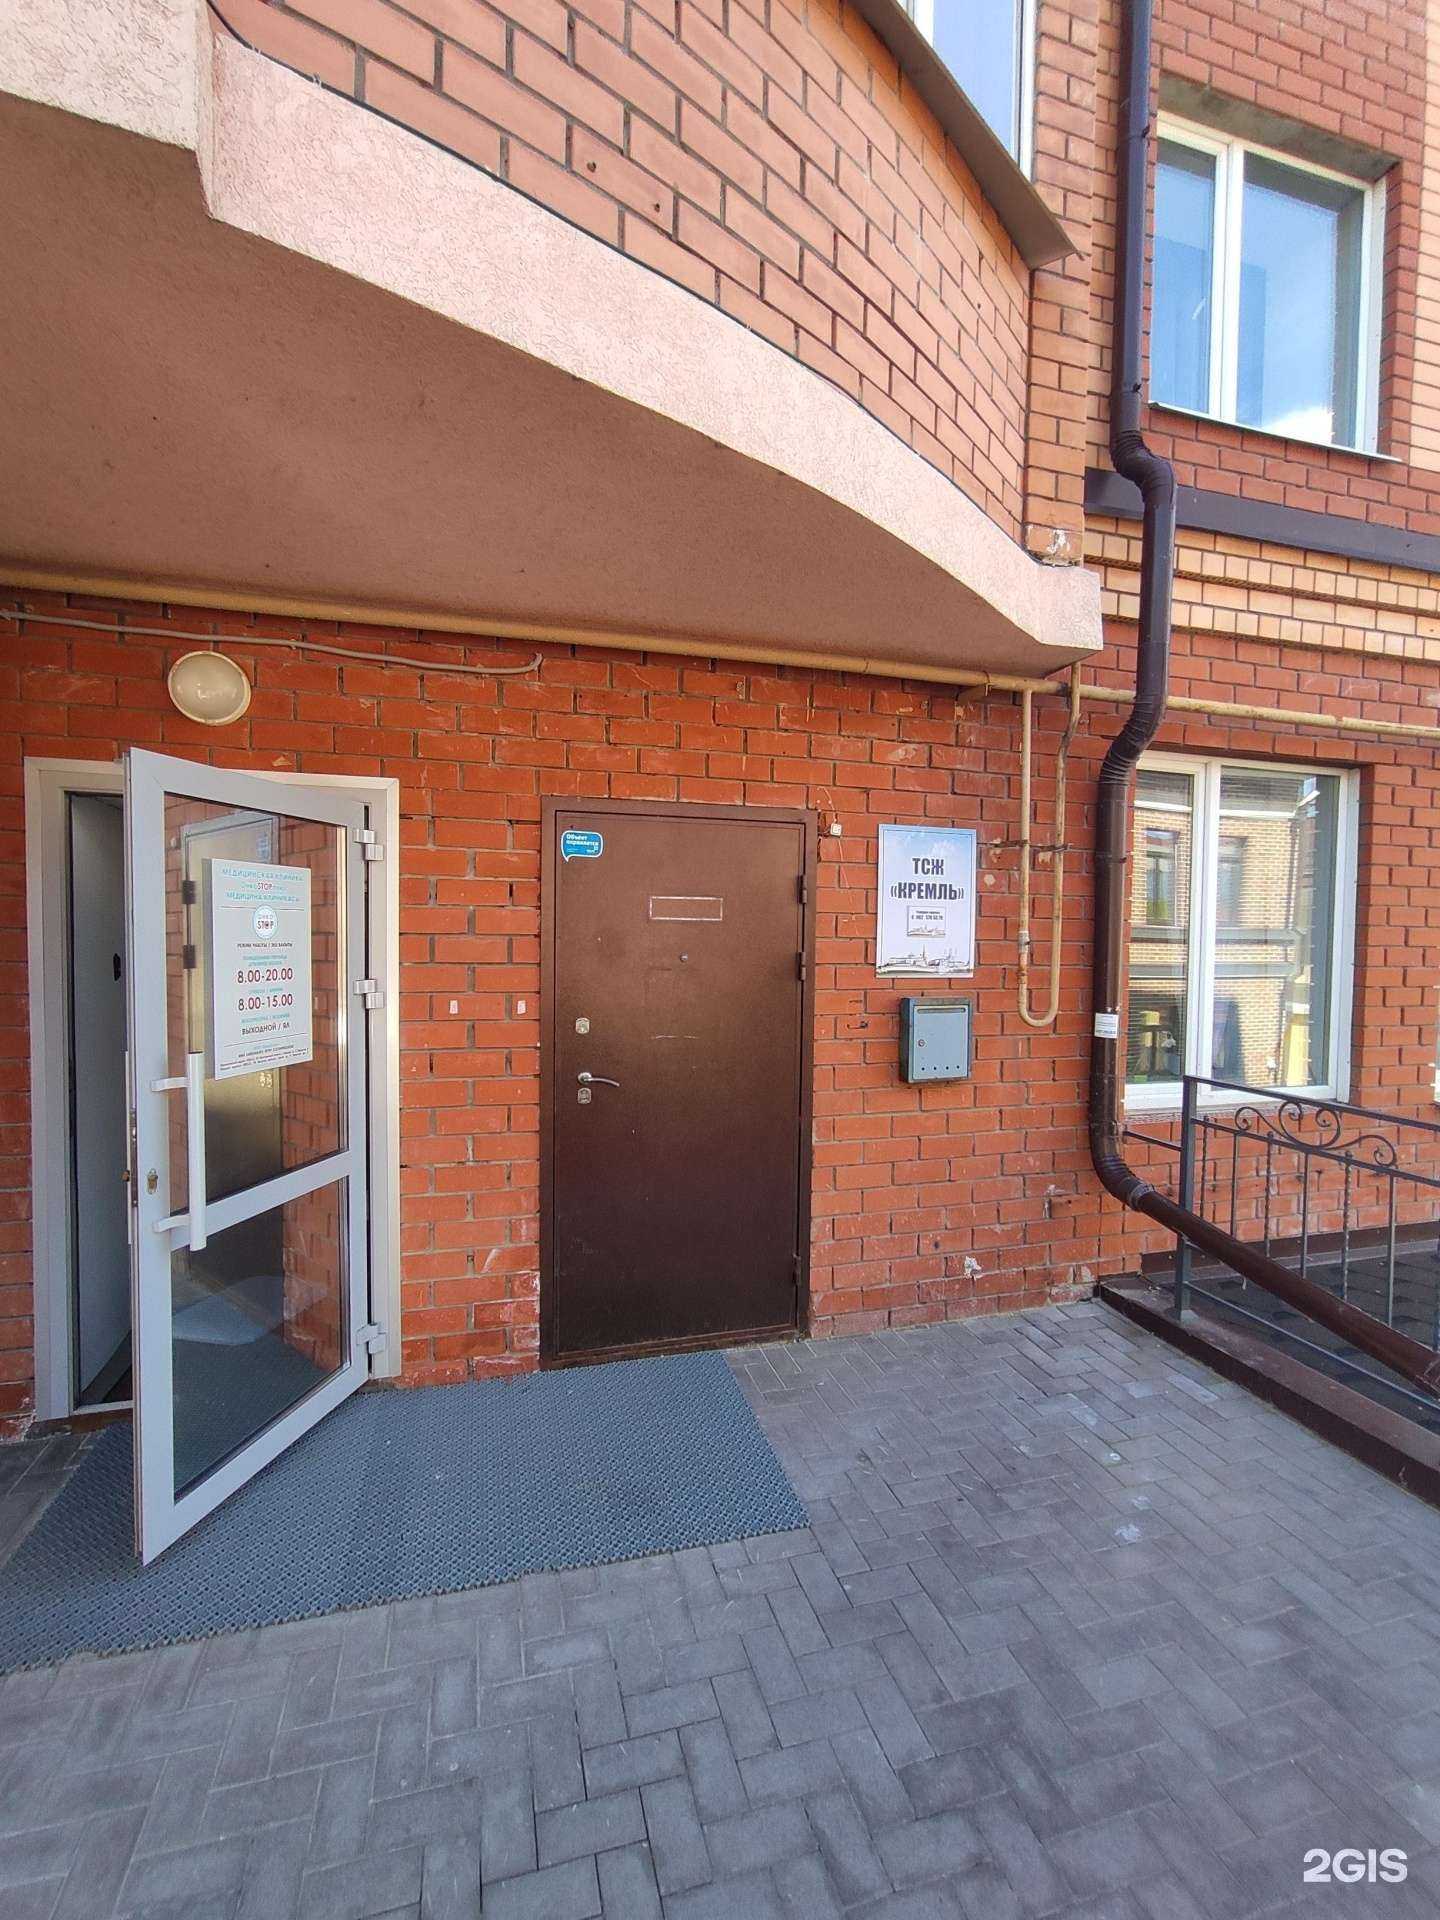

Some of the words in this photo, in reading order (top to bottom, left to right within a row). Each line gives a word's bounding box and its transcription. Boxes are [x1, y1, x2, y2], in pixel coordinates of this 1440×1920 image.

[912, 857, 944, 875] ТСЖ
[890, 882, 964, 900] «КРЕМЛЬ»
[237, 968, 293, 984] 8.00-20.00
[238, 993, 293, 1011] 8.00-15.00
[242, 1022, 276, 1035] ВЫХОДНОЙ
